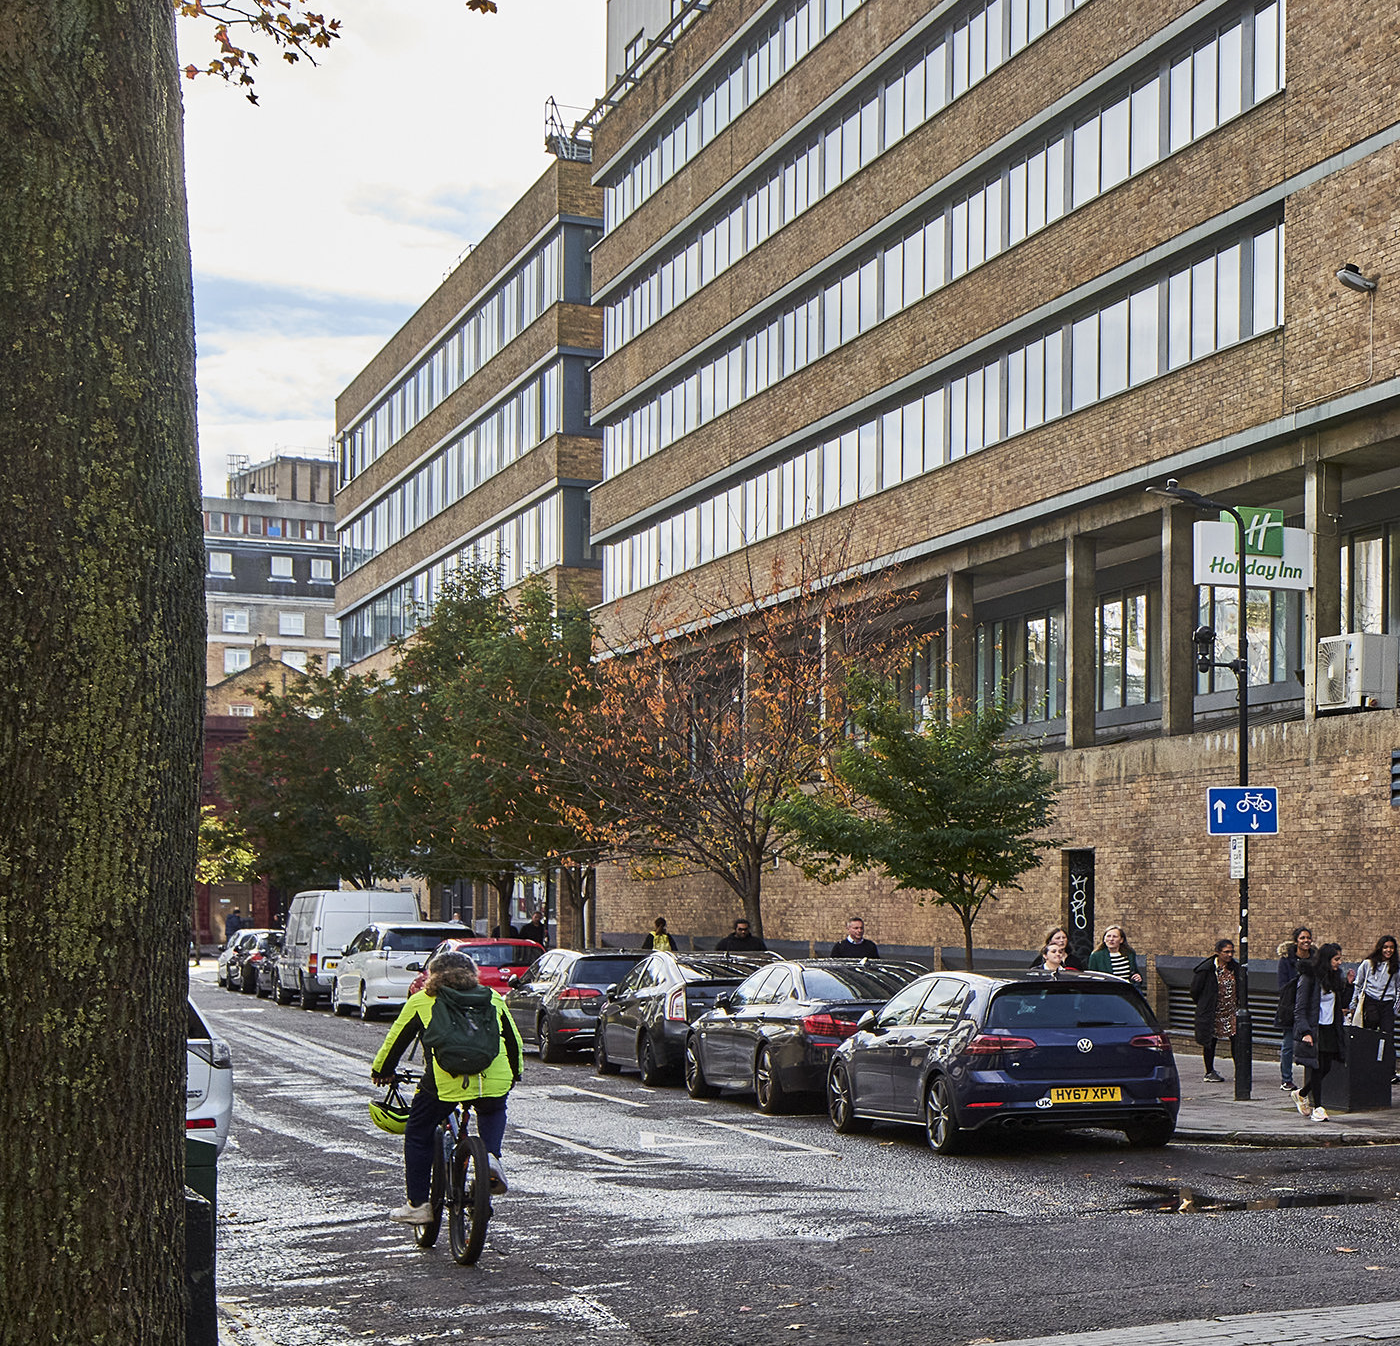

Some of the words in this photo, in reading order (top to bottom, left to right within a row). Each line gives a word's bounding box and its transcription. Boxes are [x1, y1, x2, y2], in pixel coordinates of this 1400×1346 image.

[1209, 556, 1277, 580] Holday
[1278, 561, 1303, 579] Inn
[1056, 1088, 1089, 1101] HY67
[1092, 1088, 1116, 1100] XPV
[1037, 1099, 1052, 1107] UK
